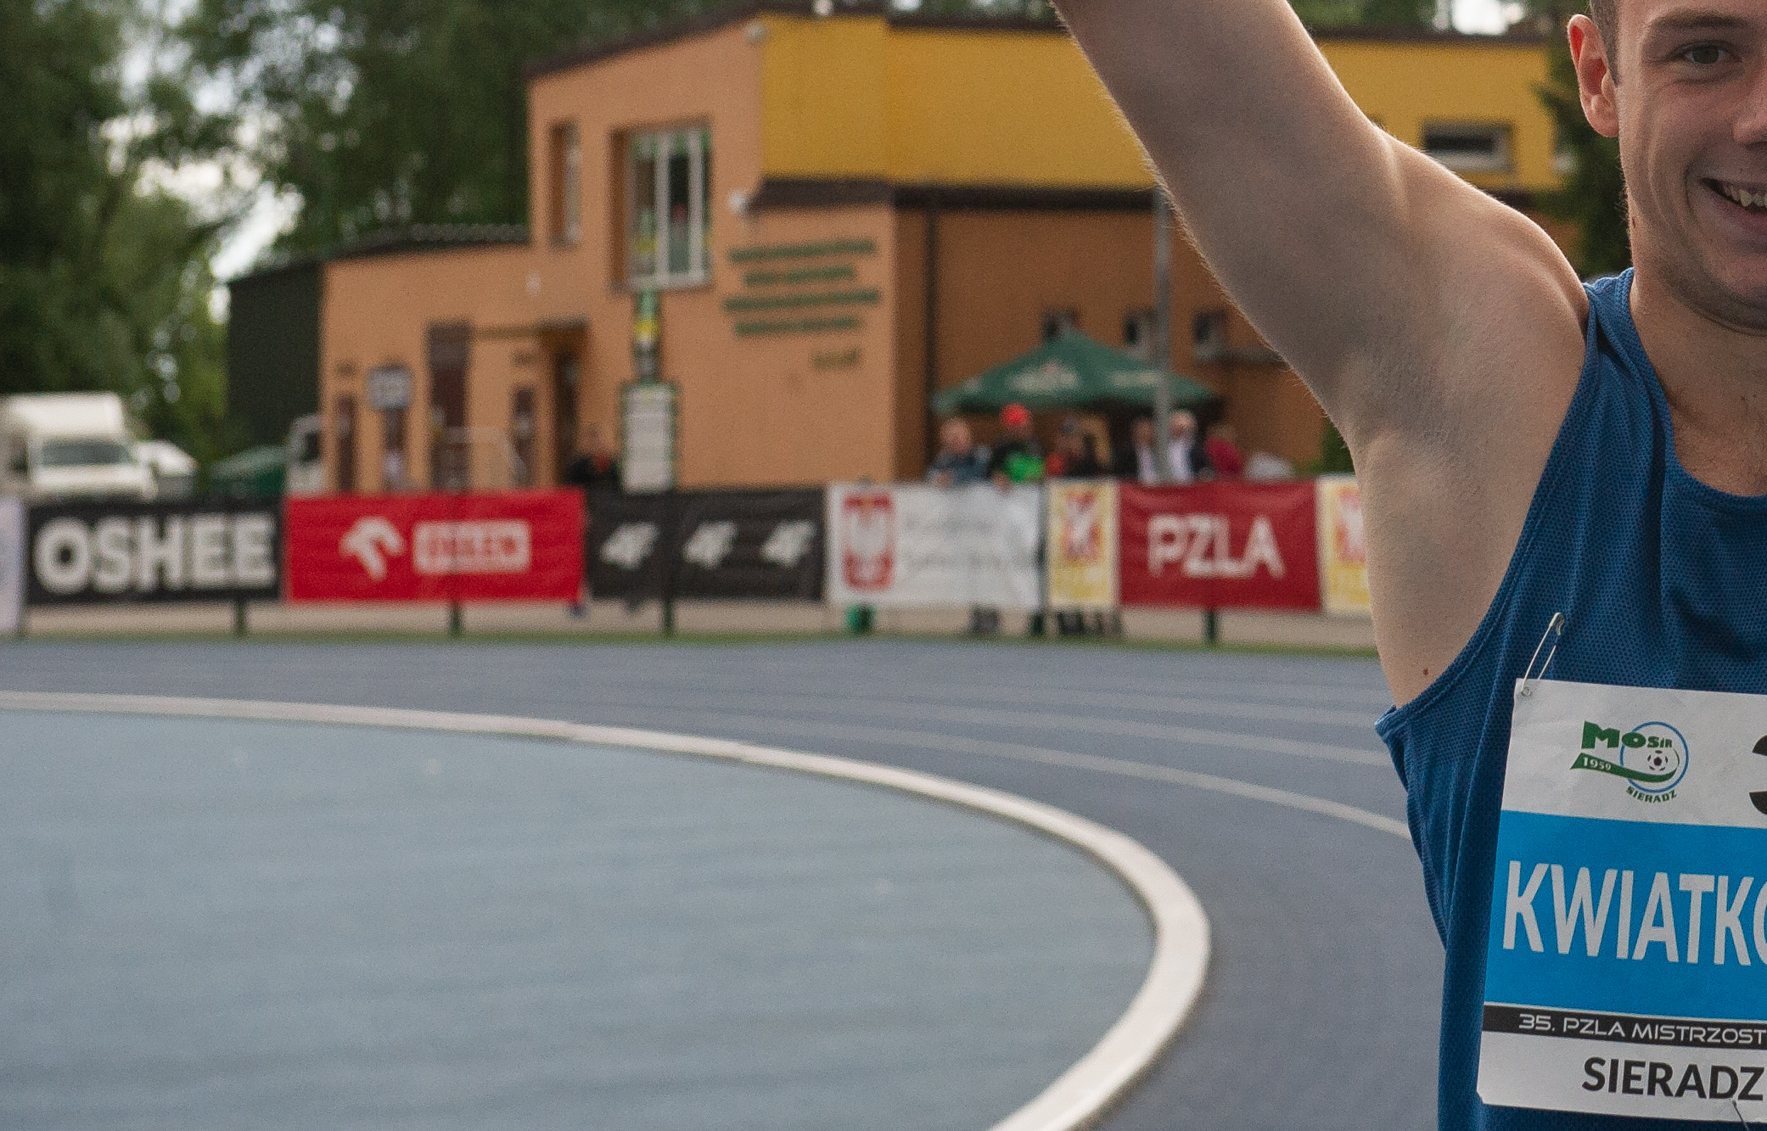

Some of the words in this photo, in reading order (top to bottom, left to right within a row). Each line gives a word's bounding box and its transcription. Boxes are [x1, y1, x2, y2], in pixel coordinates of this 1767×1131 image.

[34, 516, 276, 594] OSHEE
[1146, 514, 1285, 578] PZLA
[1582, 756, 1612, 771] 1959
[1625, 785, 1677, 804] SIERADZ
[1518, 1013, 1556, 1032] 35.
[1562, 1017, 1626, 1038] PZLA
[1581, 1056, 1765, 1102] SIERADZ
